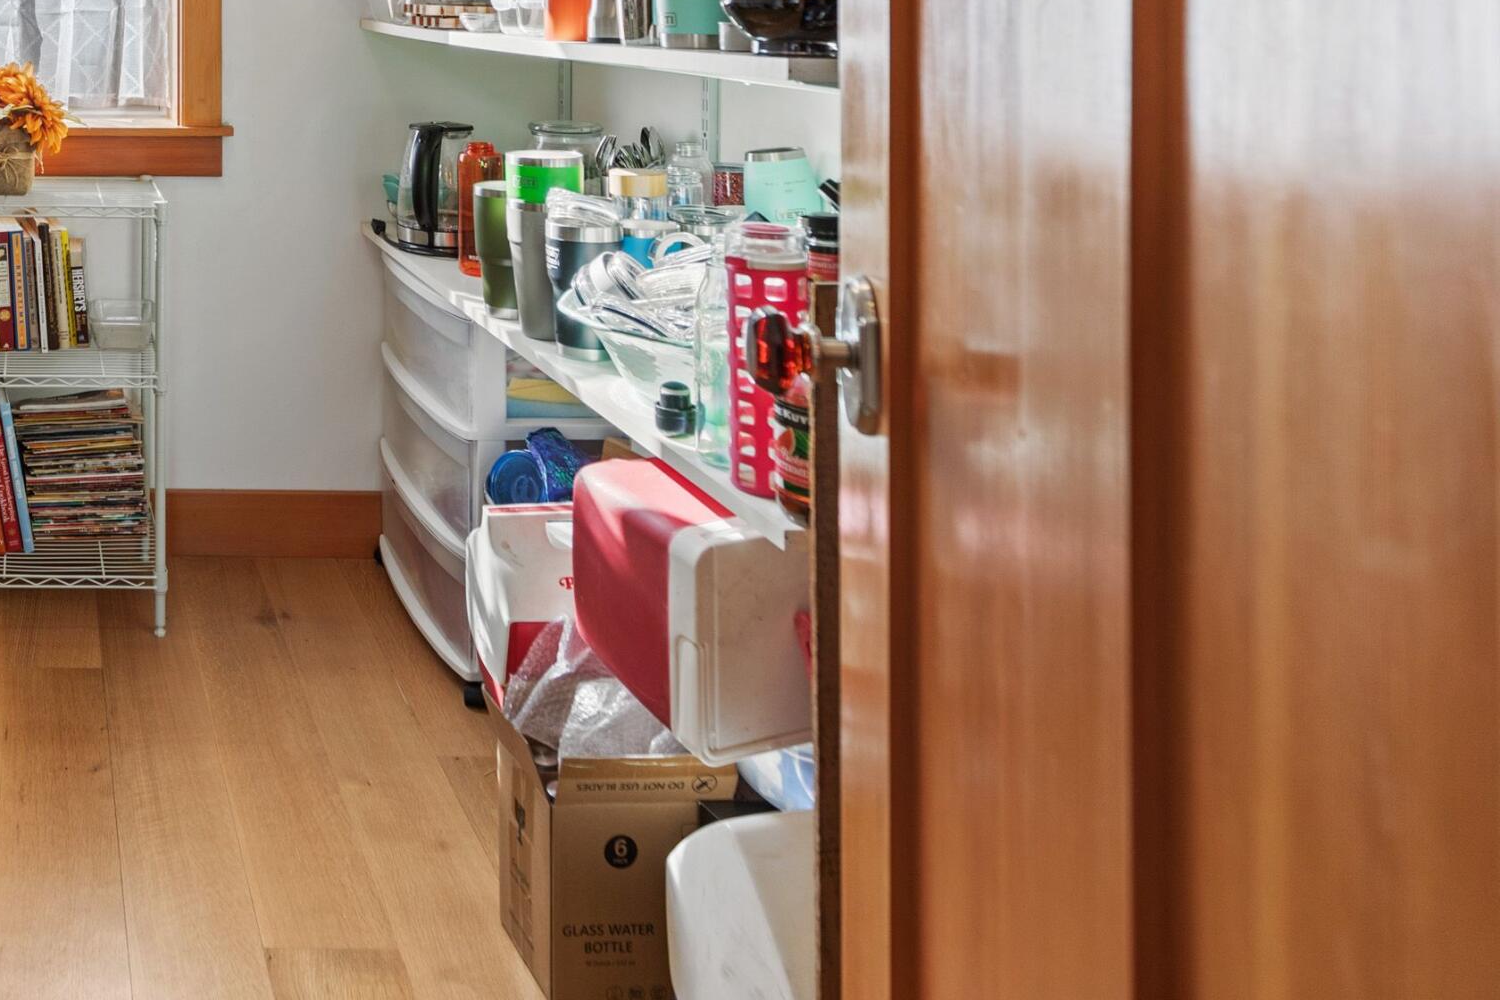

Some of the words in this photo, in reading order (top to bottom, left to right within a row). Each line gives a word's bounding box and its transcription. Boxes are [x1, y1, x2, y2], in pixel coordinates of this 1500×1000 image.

[71, 267, 87, 313] HERSHEY'S
[575, 783, 615, 792] BLADES
[618, 782, 641, 792] USE
[642, 781, 666, 791] NOT
[667, 781, 685, 791] DO
[614, 838, 628, 858] 6
[562, 923, 605, 938] GLASS
[608, 923, 655, 936] WATER
[583, 940, 633, 954] BOTTLE
